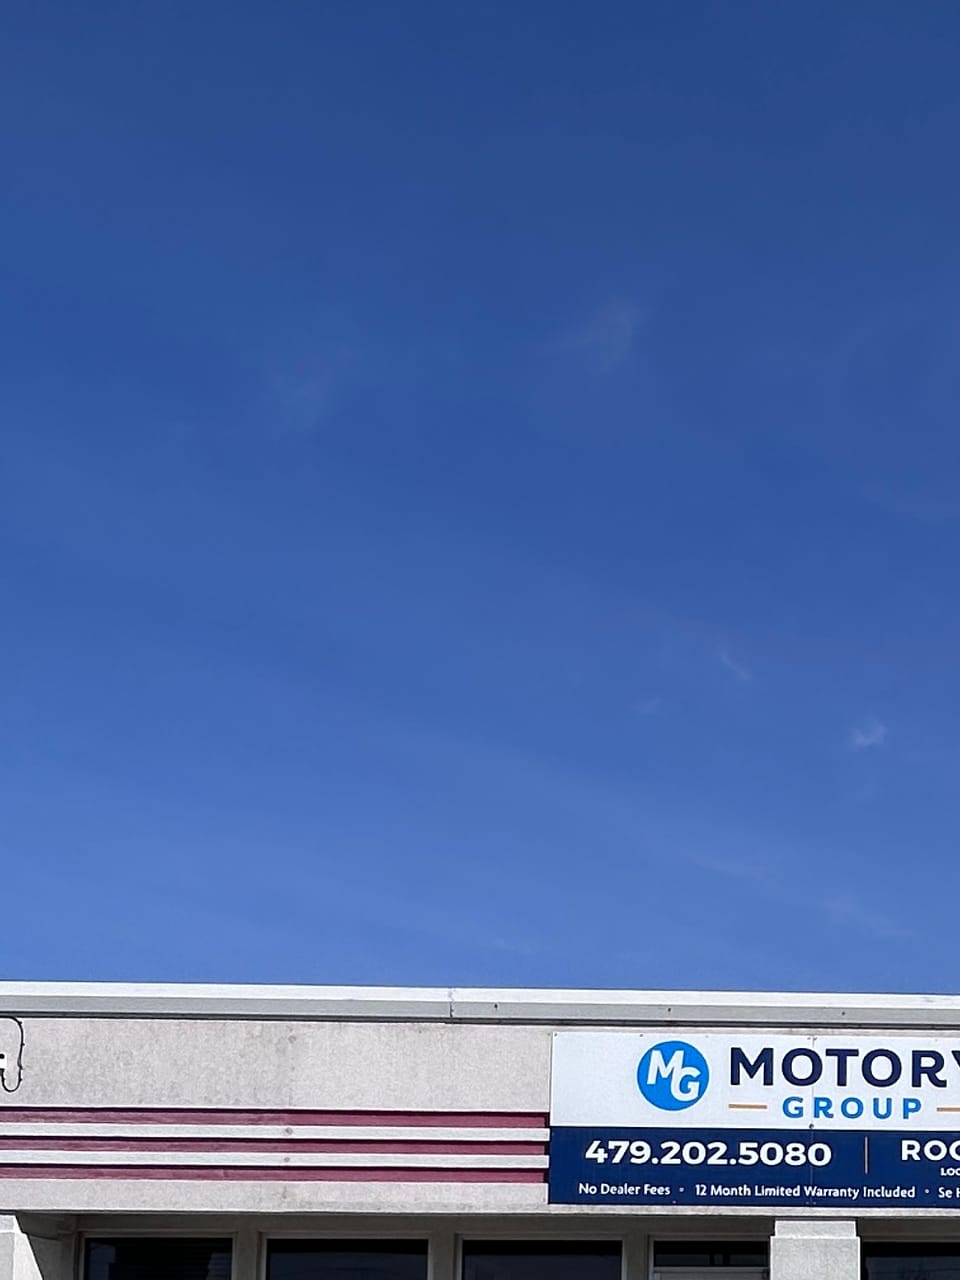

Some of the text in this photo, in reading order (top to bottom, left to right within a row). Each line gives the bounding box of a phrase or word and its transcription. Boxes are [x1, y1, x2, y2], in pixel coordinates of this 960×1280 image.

[646, 1049, 701, 1101] MG
[782, 1096, 922, 1119] GROUP
[585, 1139, 832, 1167] 479.202.5080
[578, 1183, 671, 1195] No Dealer Fees
[695, 1184, 916, 1200] 12 Month Limited Warranty Included
[938, 1187, 953, 1198] Se
